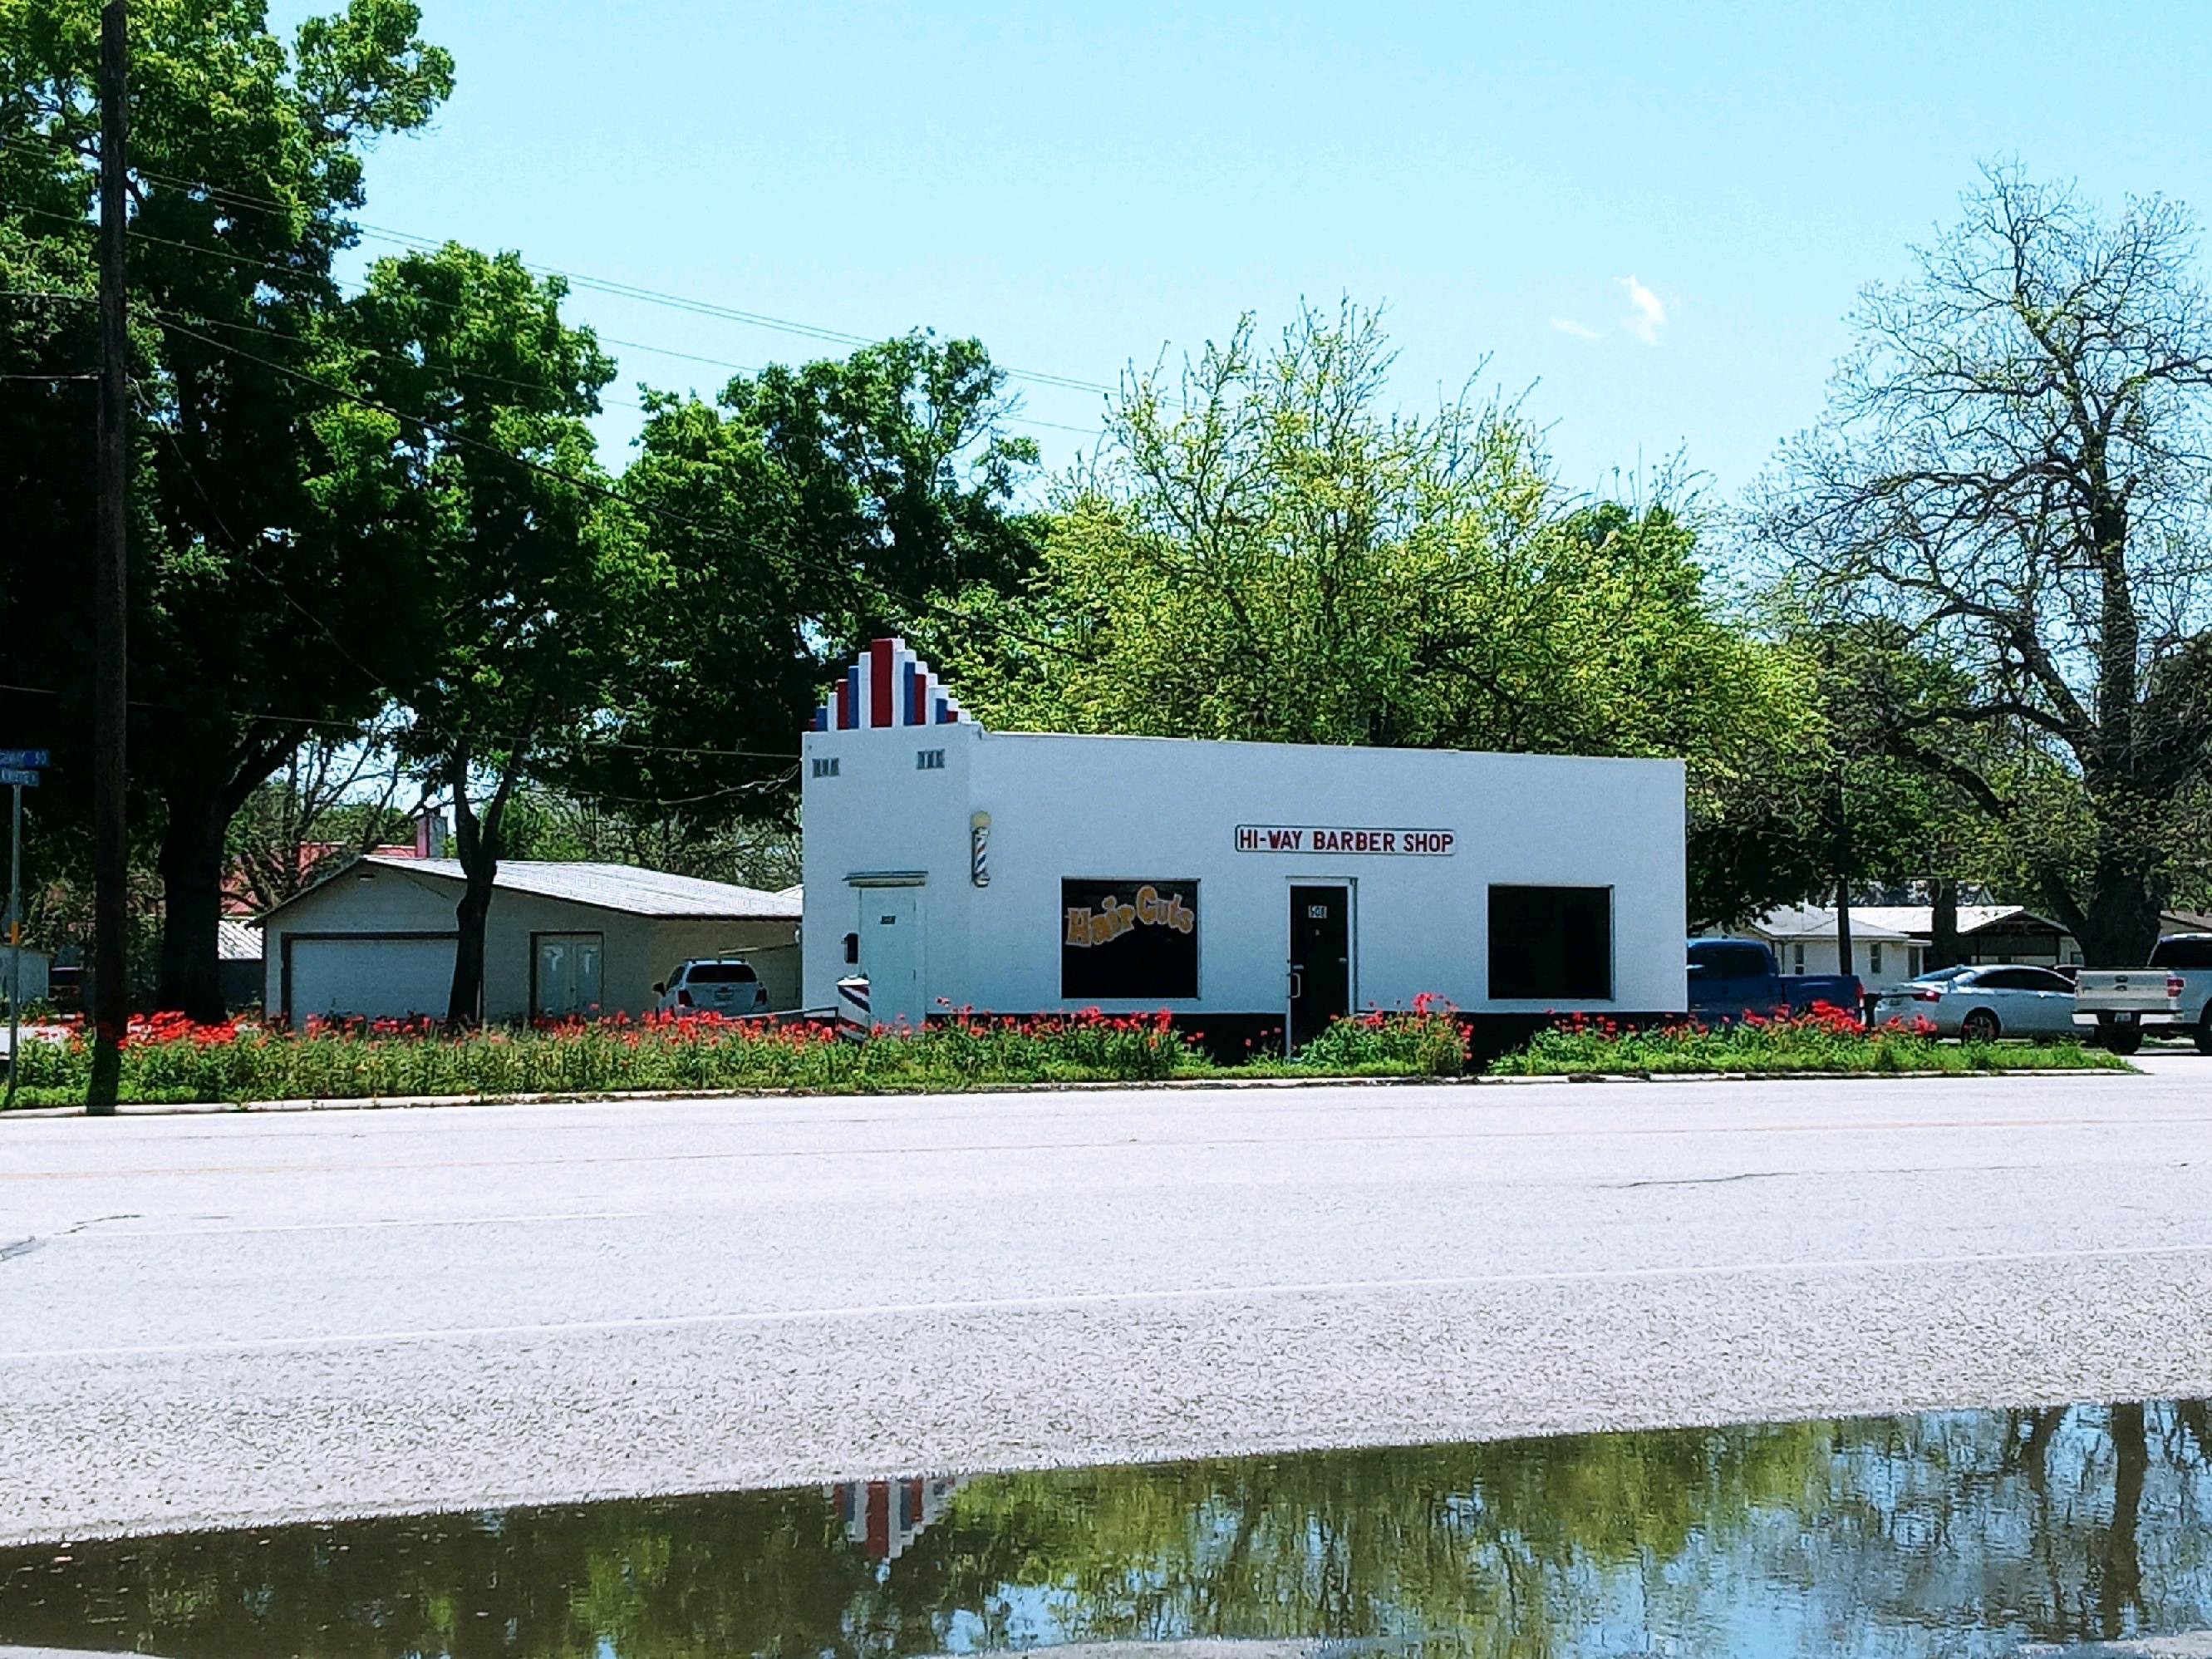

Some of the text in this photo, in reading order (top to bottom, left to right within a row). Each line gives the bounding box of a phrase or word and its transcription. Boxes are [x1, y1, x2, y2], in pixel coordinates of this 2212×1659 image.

[1239, 830, 1454, 853] HI-WAY BARBER SHOP
[1065, 885, 1195, 948] Hair Cuts
